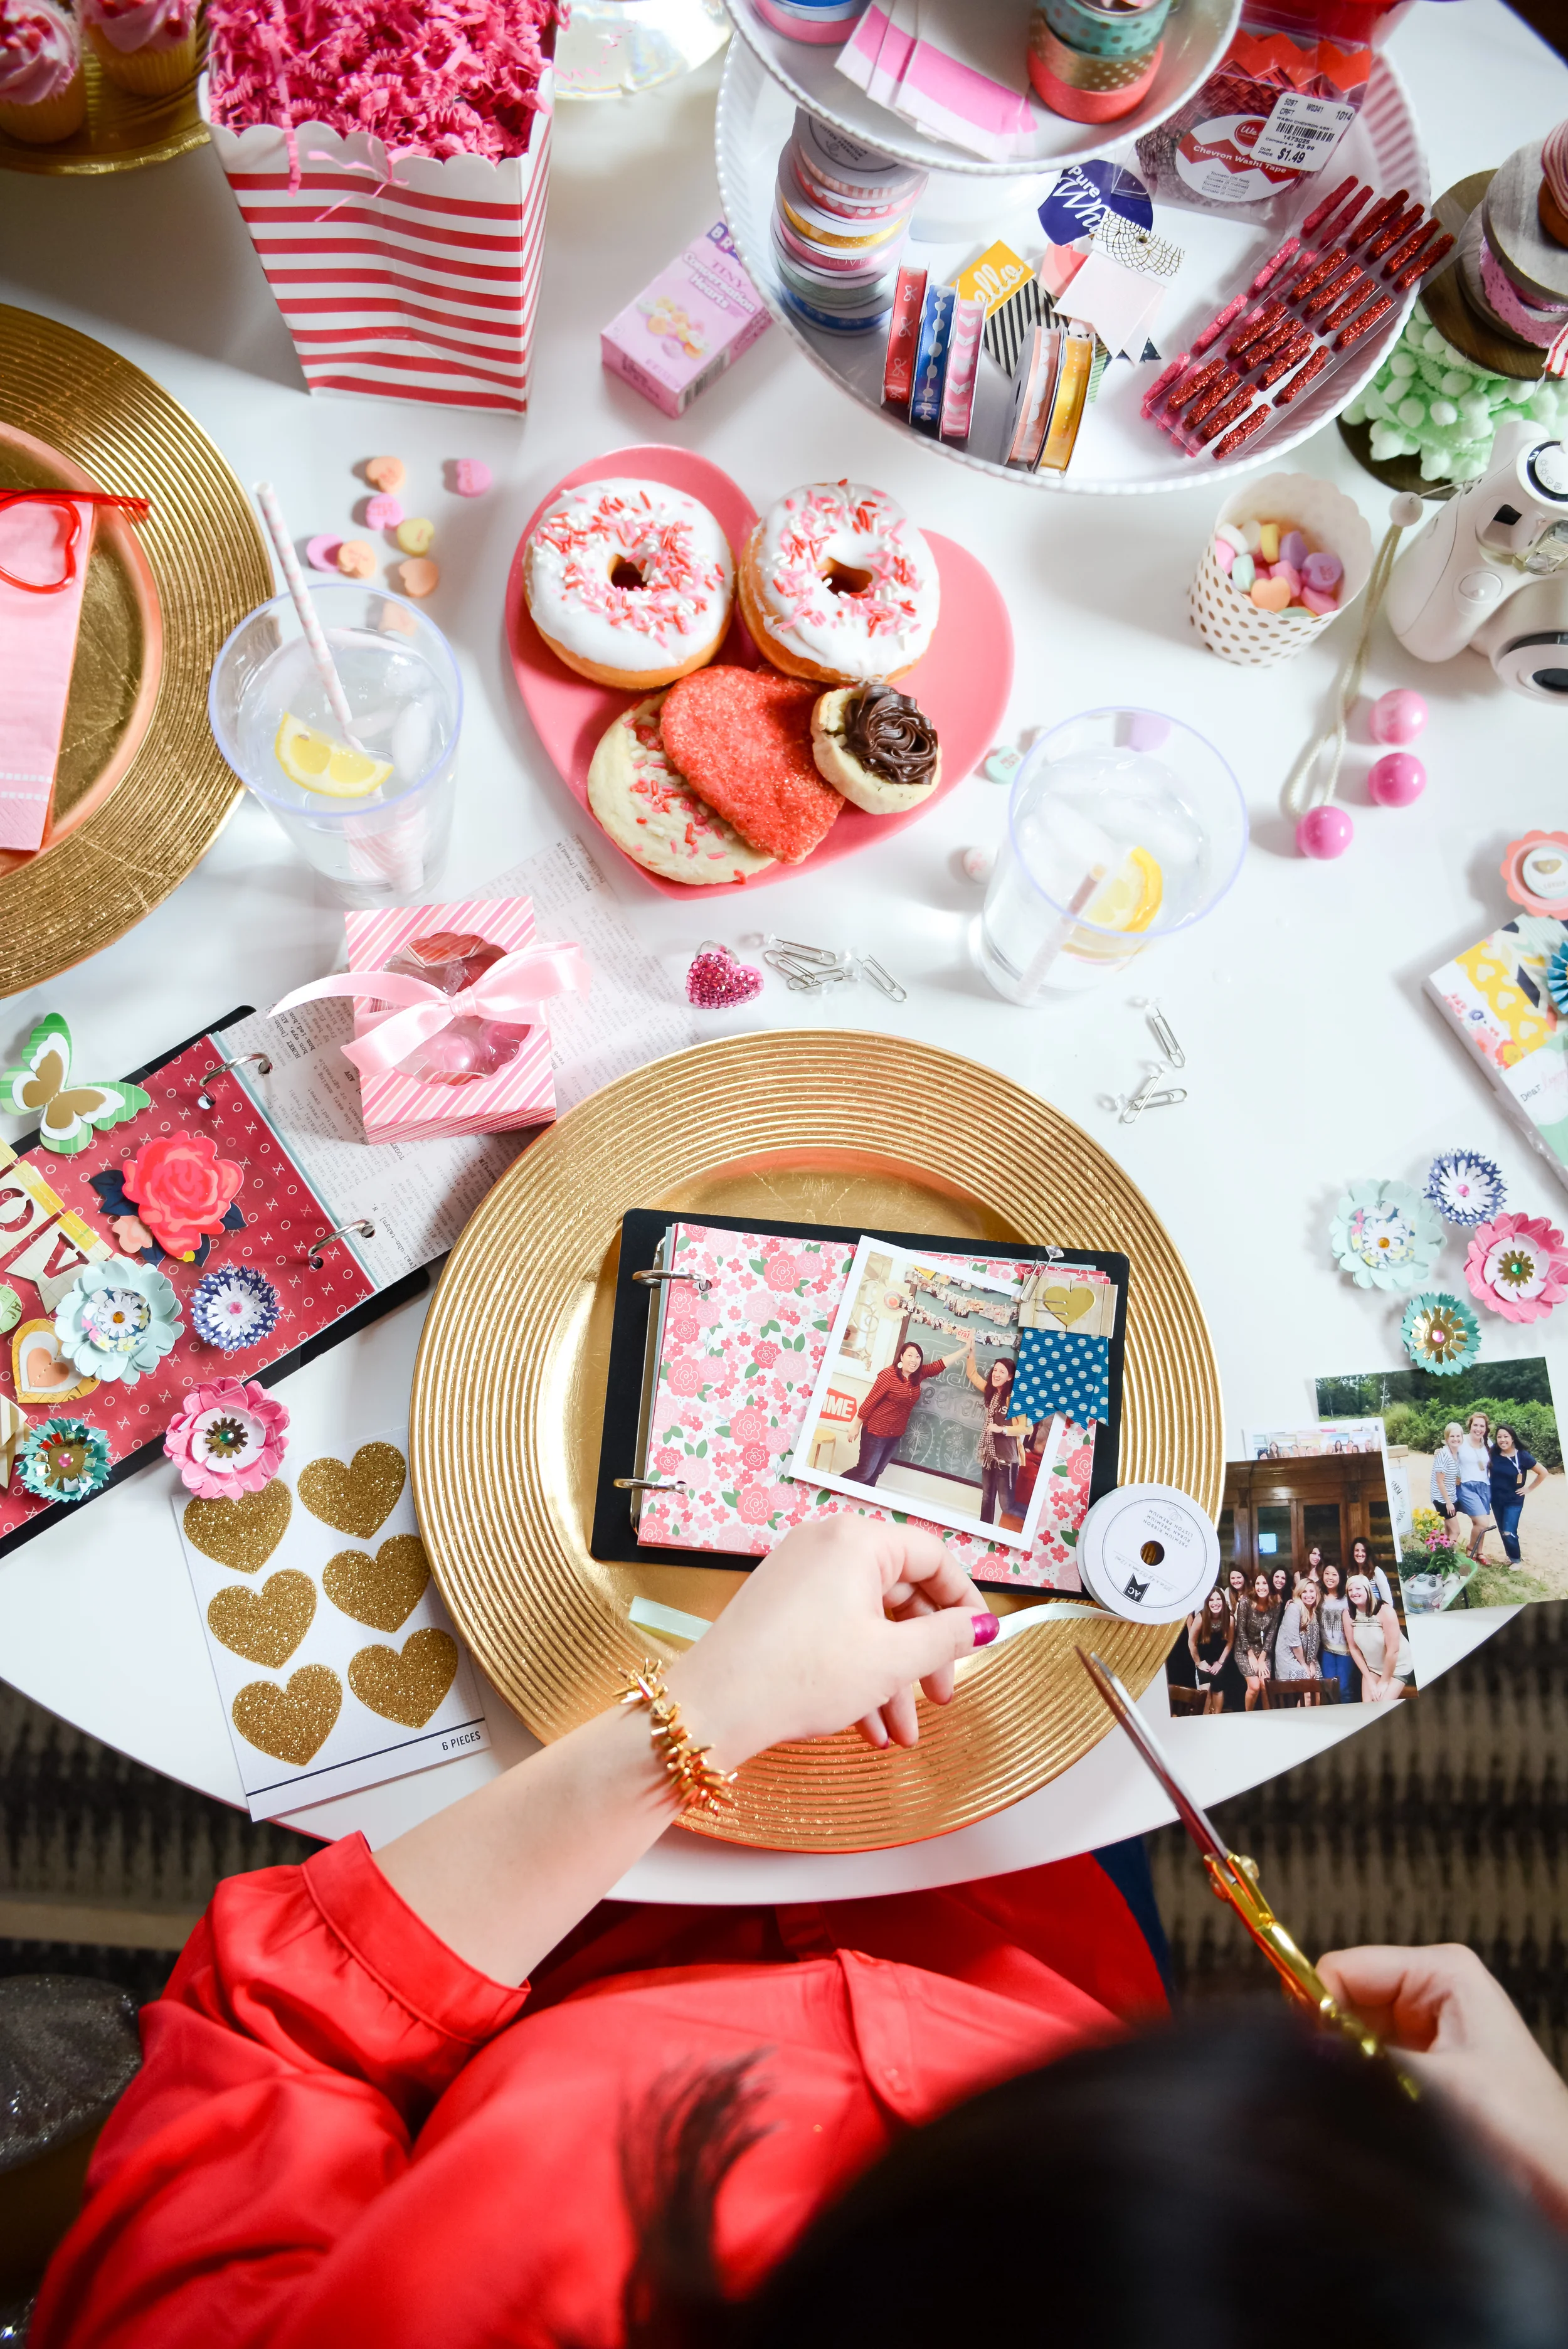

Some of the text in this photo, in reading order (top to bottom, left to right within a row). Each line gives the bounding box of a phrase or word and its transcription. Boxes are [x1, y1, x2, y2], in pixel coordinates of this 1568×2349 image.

[1335, 110, 1353, 122] 1014
[1283, 134, 1310, 144] 1473025
[1296, 143, 1314, 151] $3.99
[836, 141, 859, 161] PREMIUM
[1192, 144, 1232, 161] Chevron
[1234, 154, 1263, 169] Washi
[1277, 146, 1306, 166] $1.49
[1067, 164, 1101, 197] Pure
[827, 258, 867, 266] LOVE
[681, 250, 756, 314] Conversation
[689, 273, 731, 309] Hearts
[972, 264, 1022, 307] ello
[575, 871, 592, 891] FRIEND
[265, 1006, 301, 1059] HONEY [huhn-]
[316, 1071, 335, 1094] making
[1520, 1083, 1542, 1101] Dear
[261, 1093, 274, 1109] four
[306, 1086, 321, 1105] sweet
[317, 1057, 369, 1133] leasant, or agreeable
[272, 1111, 282, 1123] the
[277, 1103, 290, 1118] that
[304, 1098, 320, 1120] sweet.
[342, 1112, 352, 1124] the
[344, 1069, 405, 1160] TOGET ADV
[300, 1123, 308, 1132] or
[318, 1121, 334, 1140] still
[351, 1126, 359, 1134] to
[288, 1120, 314, 1156] sensations
[318, 1135, 326, 1144] or
[337, 1134, 345, 1143] or
[295, 1148, 306, 1160] the
[337, 1152, 351, 1168] milk
[312, 1158, 327, 1177] taste
[349, 1169, 362, 1185] This
[325, 1179, 340, 1197] basic
[435, 1165, 456, 1194] artistic
[370, 1202, 379, 1211] N.
[406, 1195, 415, 1204] by
[404, 1178, 452, 1248] another on Valentine
[413, 1206, 425, 1221] sent
[437, 1201, 455, 1223] chosen
[391, 1204, 428, 1257] sentimental but
[415, 1224, 438, 1256] satirical
[423, 1222, 437, 1239] gift
[349, 1234, 369, 1259] address
[435, 1240, 442, 1249] or
[1391, 1480, 1402, 1495] FARM
[1148, 1509, 1193, 1537] LISTON PREMIUM
[1142, 1519, 1188, 1547] PREMIUM RIBBON
[1172, 1529, 1190, 1542] RUBAN
[442, 1731, 480, 1751] 6 PIECES
